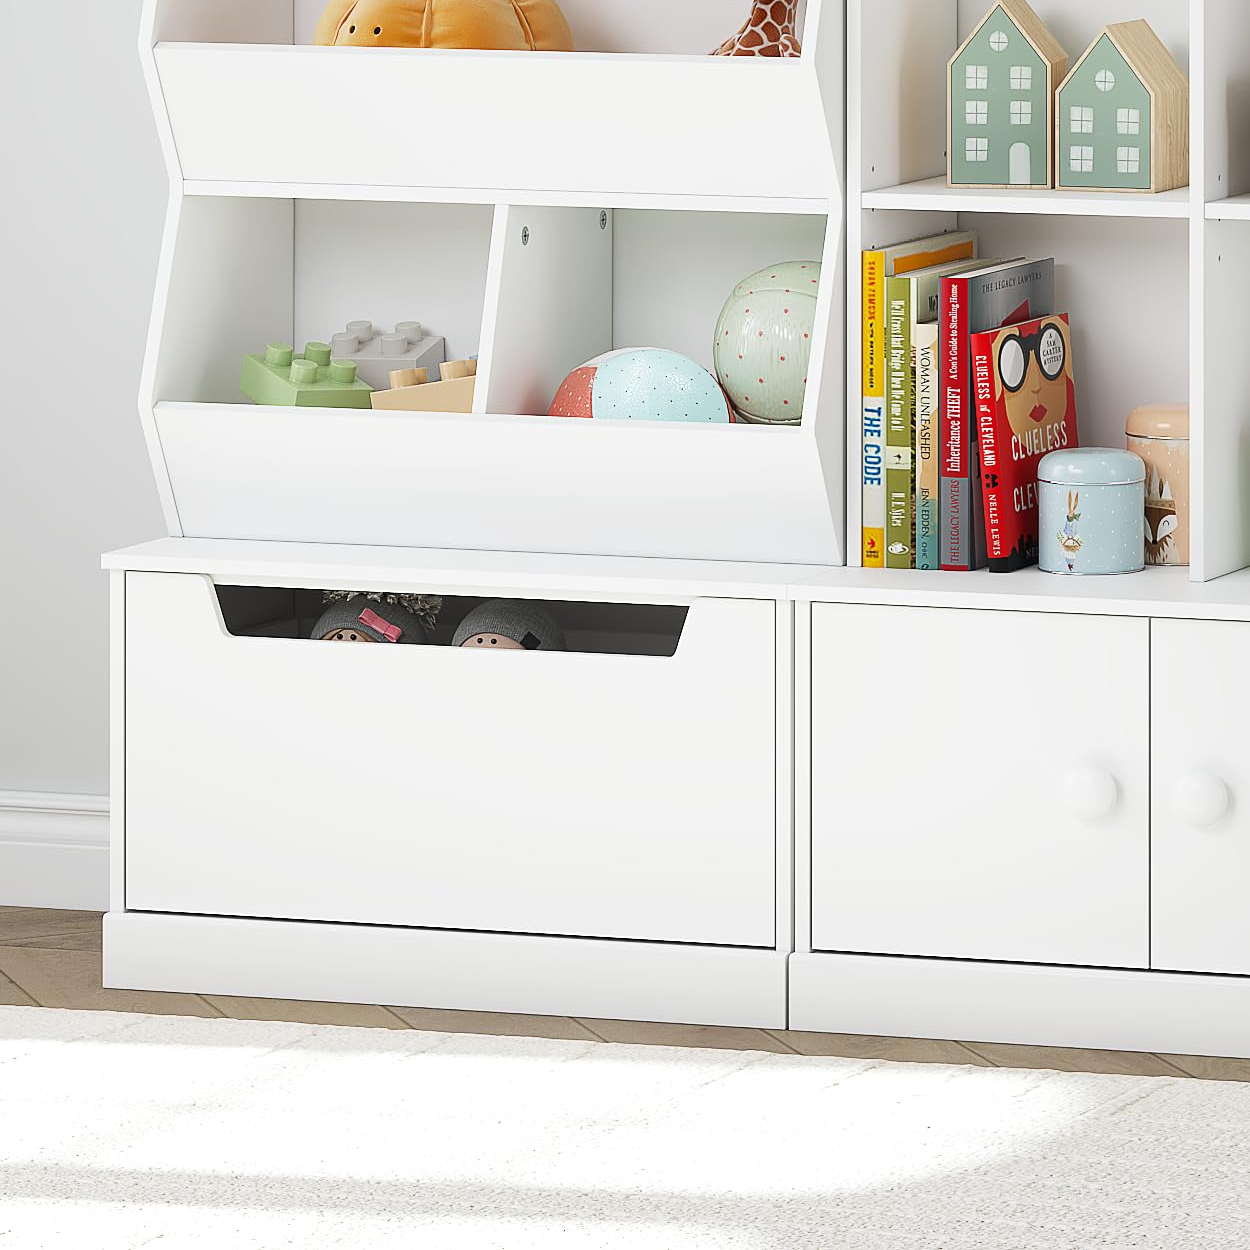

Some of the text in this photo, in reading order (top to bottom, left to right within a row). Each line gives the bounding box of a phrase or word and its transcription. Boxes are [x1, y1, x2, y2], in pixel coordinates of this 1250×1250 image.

[949, 284, 958, 303] Home
[982, 271, 1042, 293] THE LEGACY LAWYERS
[949, 303, 959, 329] Stealing
[949, 337, 958, 356] Guide
[949, 356, 958, 374] Con's
[975, 355, 990, 400] CLUELESS
[920, 347, 930, 460] WOMAN UNLEASHED
[864, 407, 882, 485] THE CODE
[946, 387, 961, 473] Inheritance THEFT
[980, 416, 996, 467] CLEVELAND
[1011, 420, 1068, 461] CLUELESS
[889, 509, 905, 526] Sykes
[920, 488, 930, 508] JENN
[950, 480, 960, 562] THE LEGACY LAWYERS
[988, 494, 1001, 556] NELLE LEWIS
